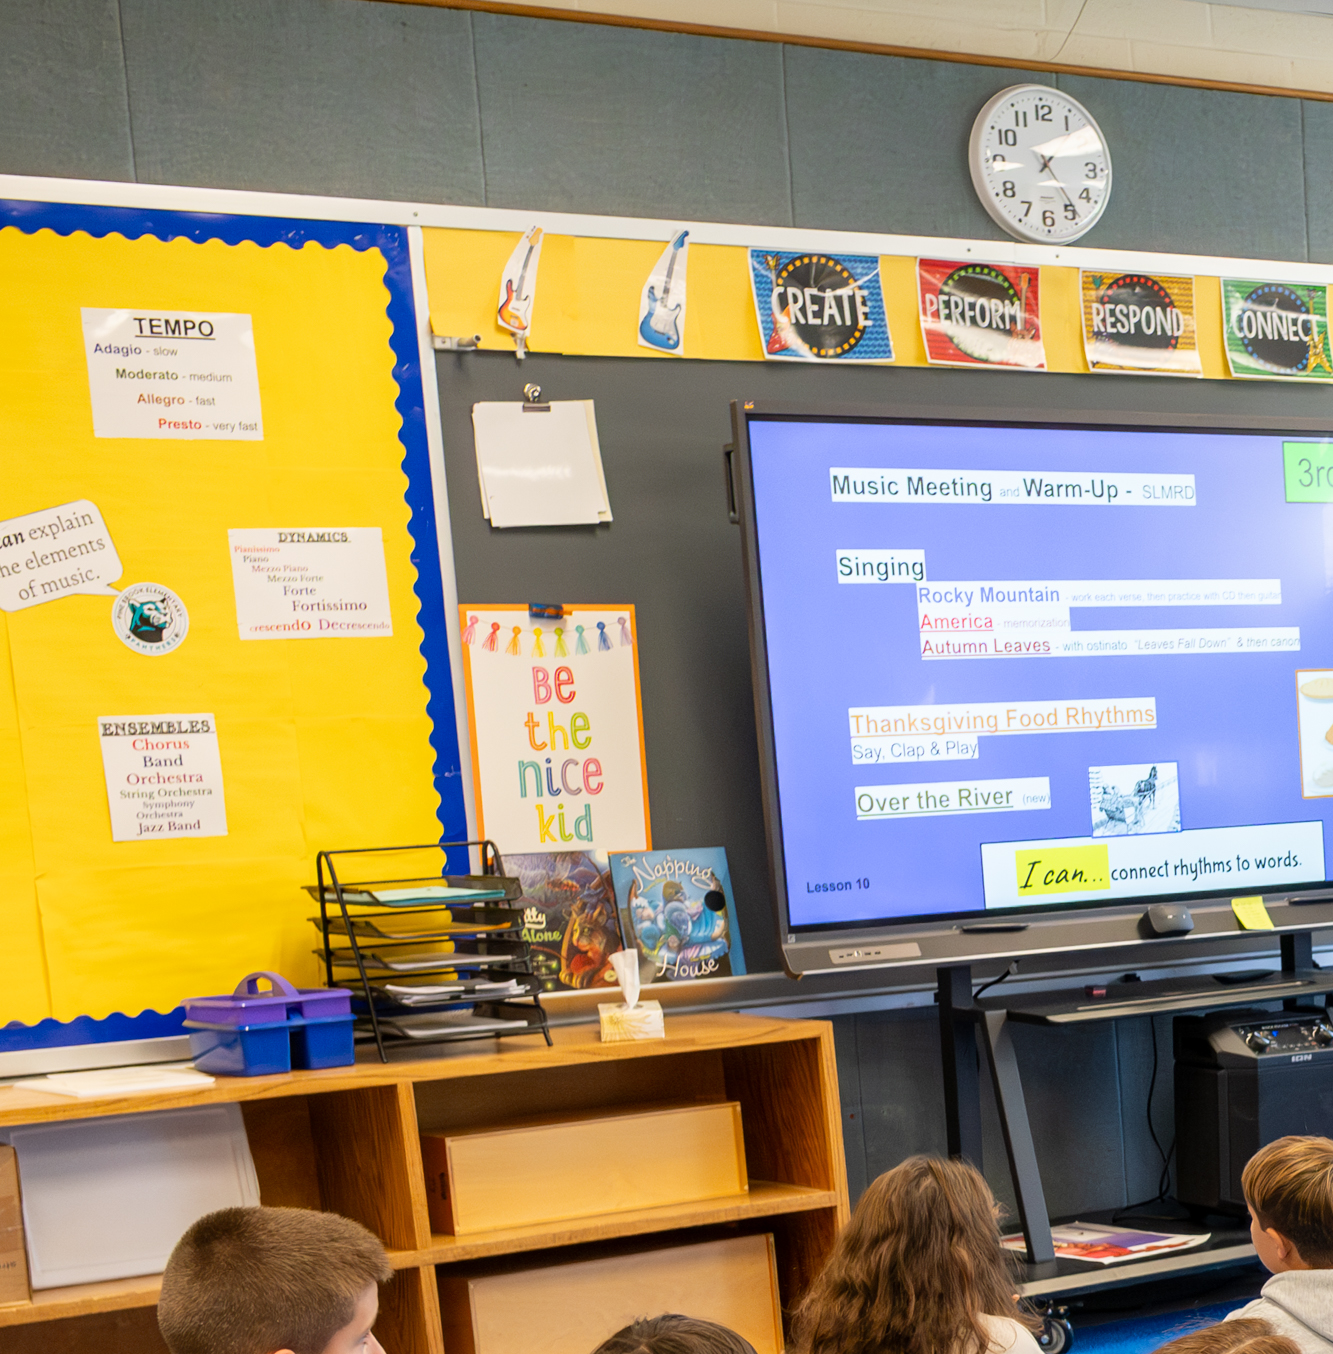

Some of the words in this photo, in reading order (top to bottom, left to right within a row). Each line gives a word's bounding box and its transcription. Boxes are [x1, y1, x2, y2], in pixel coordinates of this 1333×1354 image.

[1015, 110, 1028, 127] 11
[1035, 104, 1052, 122] 12
[1065, 115, 1069, 131] 1
[998, 129, 1017, 146] 10
[1085, 162, 1097, 179] 3
[1002, 181, 1016, 198] 8
[1079, 188, 1092, 203] 4
[1020, 201, 1032, 217] 7
[1064, 203, 1076, 221] 5
[1042, 210, 1055, 227] 6
[771, 286, 874, 327] CREATE
[924, 293, 1025, 330] PERFORM
[134, 318, 214, 337] TEMPO
[1091, 302, 1184, 337] RESPOND
[1231, 309, 1321, 343] CONNECT
[94, 344, 142, 357] Adagio
[153, 347, 178, 356] slow
[115, 368, 178, 380] Moderato
[189, 372, 232, 382] medium
[137, 394, 185, 407] Allegro
[196, 396, 216, 406] fast
[158, 418, 202, 429] Presto
[212, 423, 236, 433] very
[239, 422, 258, 431] fast
[832, 474, 899, 497] Music
[907, 476, 993, 502] Meeting
[999, 484, 1021, 498] and
[1022, 478, 1117, 502] Warm-Up
[1142, 485, 1195, 500] SLMRD
[28, 512, 94, 540] explain
[277, 532, 348, 543] DYNAMICS
[25, 537, 106, 570] elements
[234, 545, 280, 553] Pianissimo
[243, 555, 269, 563] Piano
[252, 565, 281, 573] Mezzo
[838, 556, 925, 582] Singing
[18, 580, 37, 601] of
[40, 568, 100, 595] music.
[267, 575, 298, 583] Mezzo
[300, 574, 324, 582] Forte
[283, 586, 317, 596] Forte
[918, 587, 974, 608] Rocky
[979, 586, 1060, 604] Mountain
[1072, 593, 1092, 601] work
[1095, 593, 1115, 601] each
[1147, 593, 1166, 601] then
[1168, 592, 1201, 602] practice
[1203, 592, 1220, 600] with
[1222, 591, 1236, 600] CD
[1238, 591, 1256, 600] then
[292, 599, 368, 612] Fortissimo
[249, 619, 312, 632] crescendo
[319, 618, 390, 631] Decrescendo
[919, 613, 994, 631] America
[1002, 616, 1070, 629] memorization
[921, 639, 989, 656] Autumn
[994, 638, 1051, 654] Leaves
[1063, 640, 1083, 651] with
[1087, 640, 1128, 651] ostinato
[1178, 638, 1196, 649] Fall
[1236, 636, 1244, 648] &
[1247, 636, 1268, 647] then
[1270, 637, 1300, 647] canon
[101, 720, 211, 736] ENSEMBLES
[850, 712, 999, 736] Thanksgiving
[1006, 708, 1059, 729] Food
[1066, 705, 1156, 729] Rhythms
[524, 711, 592, 752] the
[132, 738, 190, 751] Chorus
[852, 743, 886, 761] Say,
[890, 742, 926, 759] Clap
[929, 742, 941, 756] &
[946, 740, 978, 759] Play
[143, 754, 183, 768] Band
[126, 772, 204, 785] Orchestra
[518, 757, 605, 799] nice
[120, 789, 155, 800] String
[158, 787, 213, 798] Orchestra
[857, 792, 910, 814] Over
[916, 790, 950, 811] the
[958, 788, 1013, 808] River
[1021, 792, 1051, 806] (new)
[143, 799, 195, 810] Symphony
[136, 811, 184, 820] Orchestra
[535, 803, 595, 844] kid
[137, 822, 164, 836] Jazz
[168, 820, 201, 831] Band
[632, 855, 714, 895] Napping
[1019, 859, 1041, 891] I
[1042, 867, 1104, 887] can...
[1111, 860, 1169, 882] connect
[1173, 855, 1233, 881] rhythms
[1236, 853, 1250, 872] to
[1254, 850, 1303, 870] words.
[806, 879, 852, 894] Lesson
[855, 878, 871, 891] 10
[522, 929, 562, 943] Alone
[656, 953, 719, 978] House
